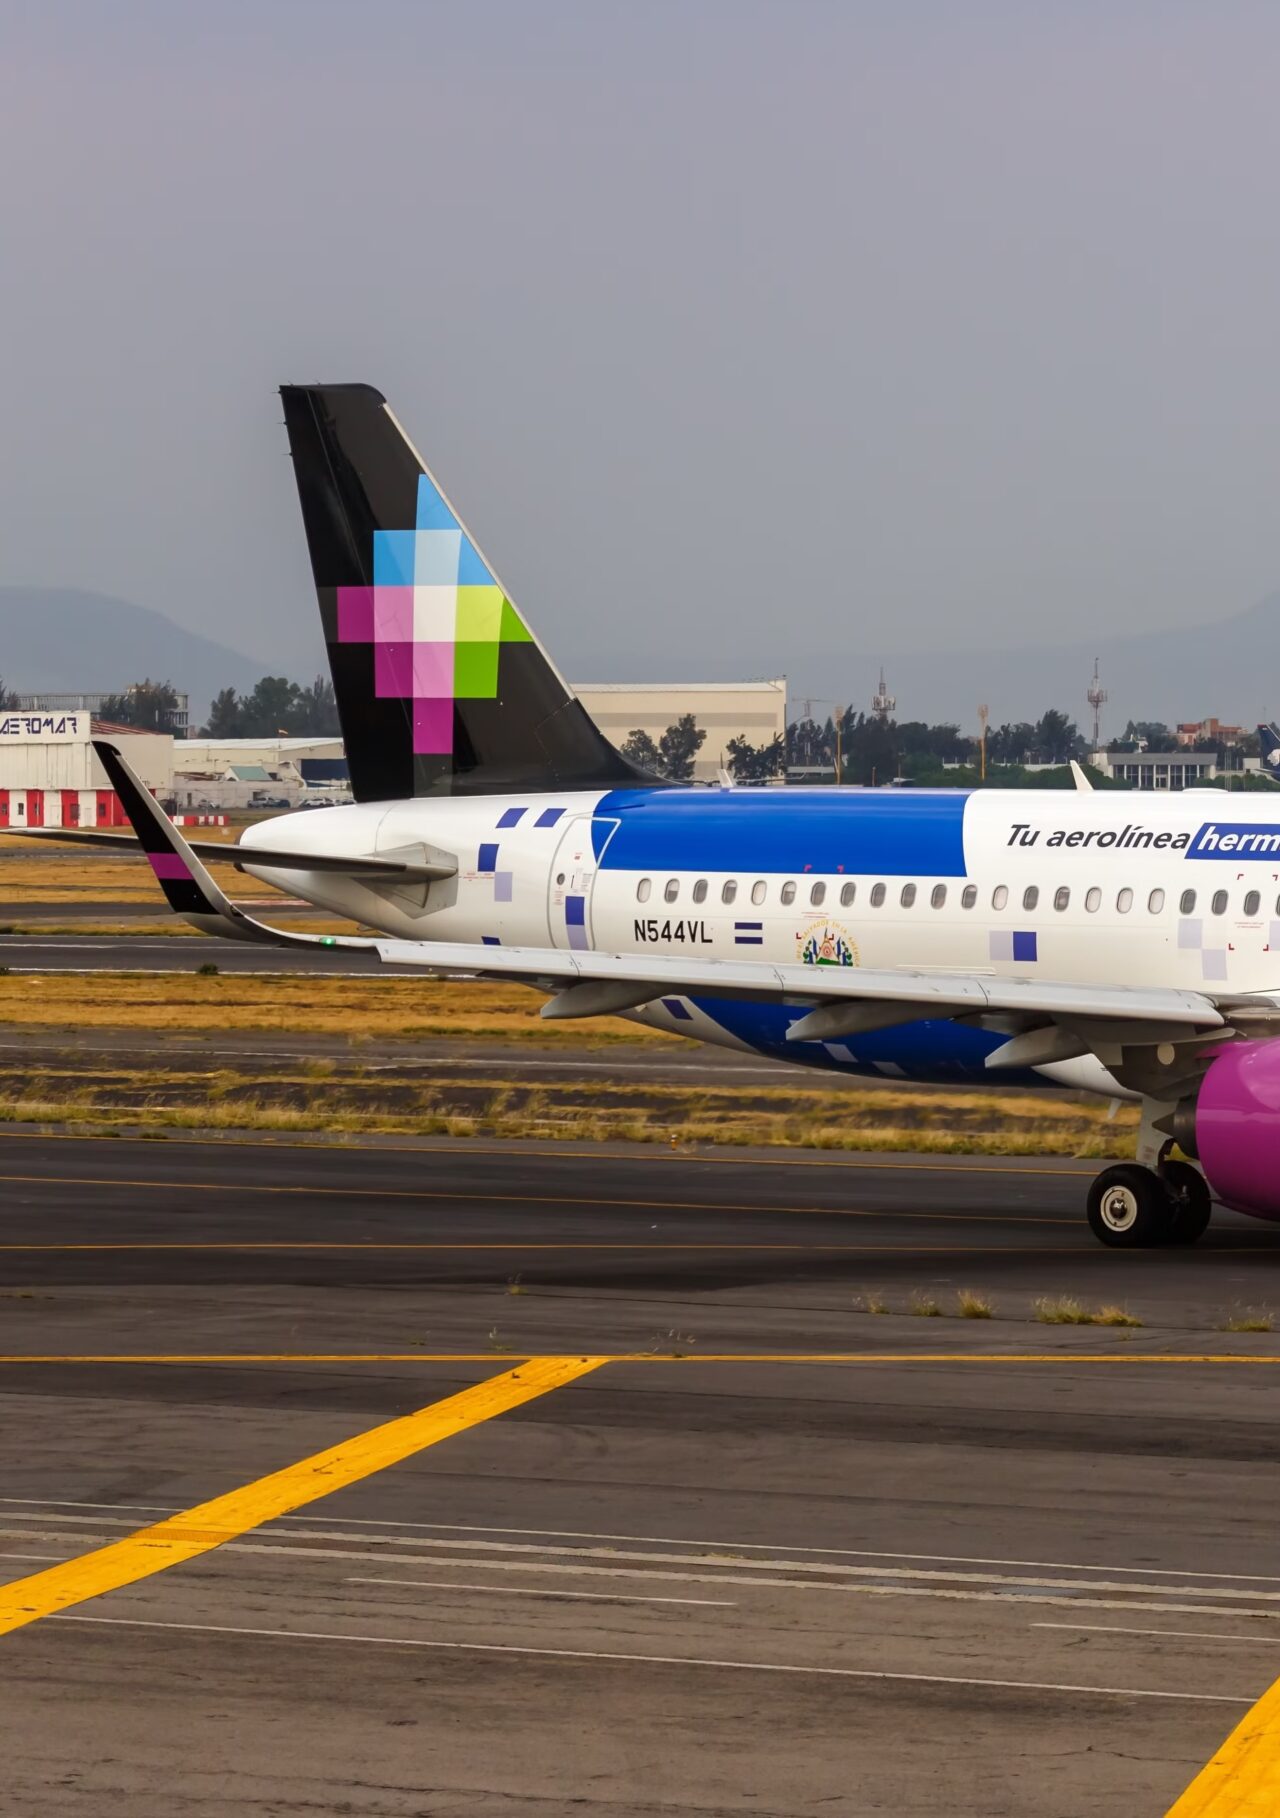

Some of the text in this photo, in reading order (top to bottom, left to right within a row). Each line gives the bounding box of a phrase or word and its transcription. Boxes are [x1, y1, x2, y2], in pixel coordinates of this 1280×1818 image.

[0, 717, 77, 734] AEROMAR
[1007, 824, 1040, 847] Tu
[1046, 825, 1190, 849] aerolínea
[634, 919, 713, 943] N544VL
